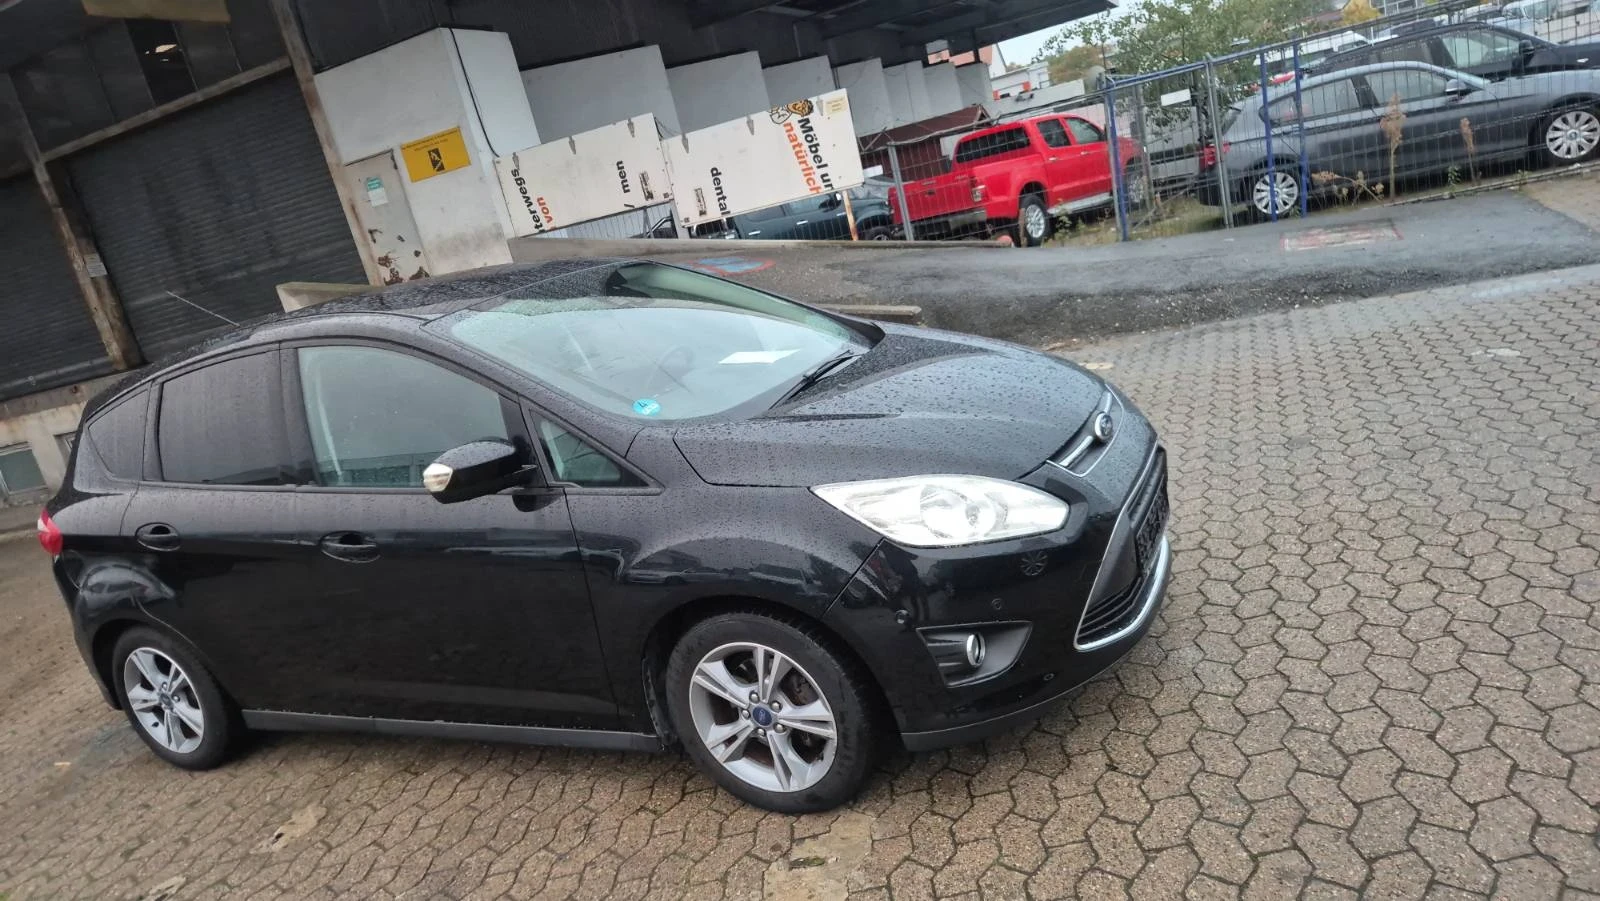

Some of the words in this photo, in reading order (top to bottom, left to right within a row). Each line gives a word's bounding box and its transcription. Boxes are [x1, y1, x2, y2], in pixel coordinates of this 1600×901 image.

[798, 117, 829, 170] Möbel
[616, 160, 631, 193] men
[710, 167, 731, 215] dental
[536, 196, 553, 224] von
